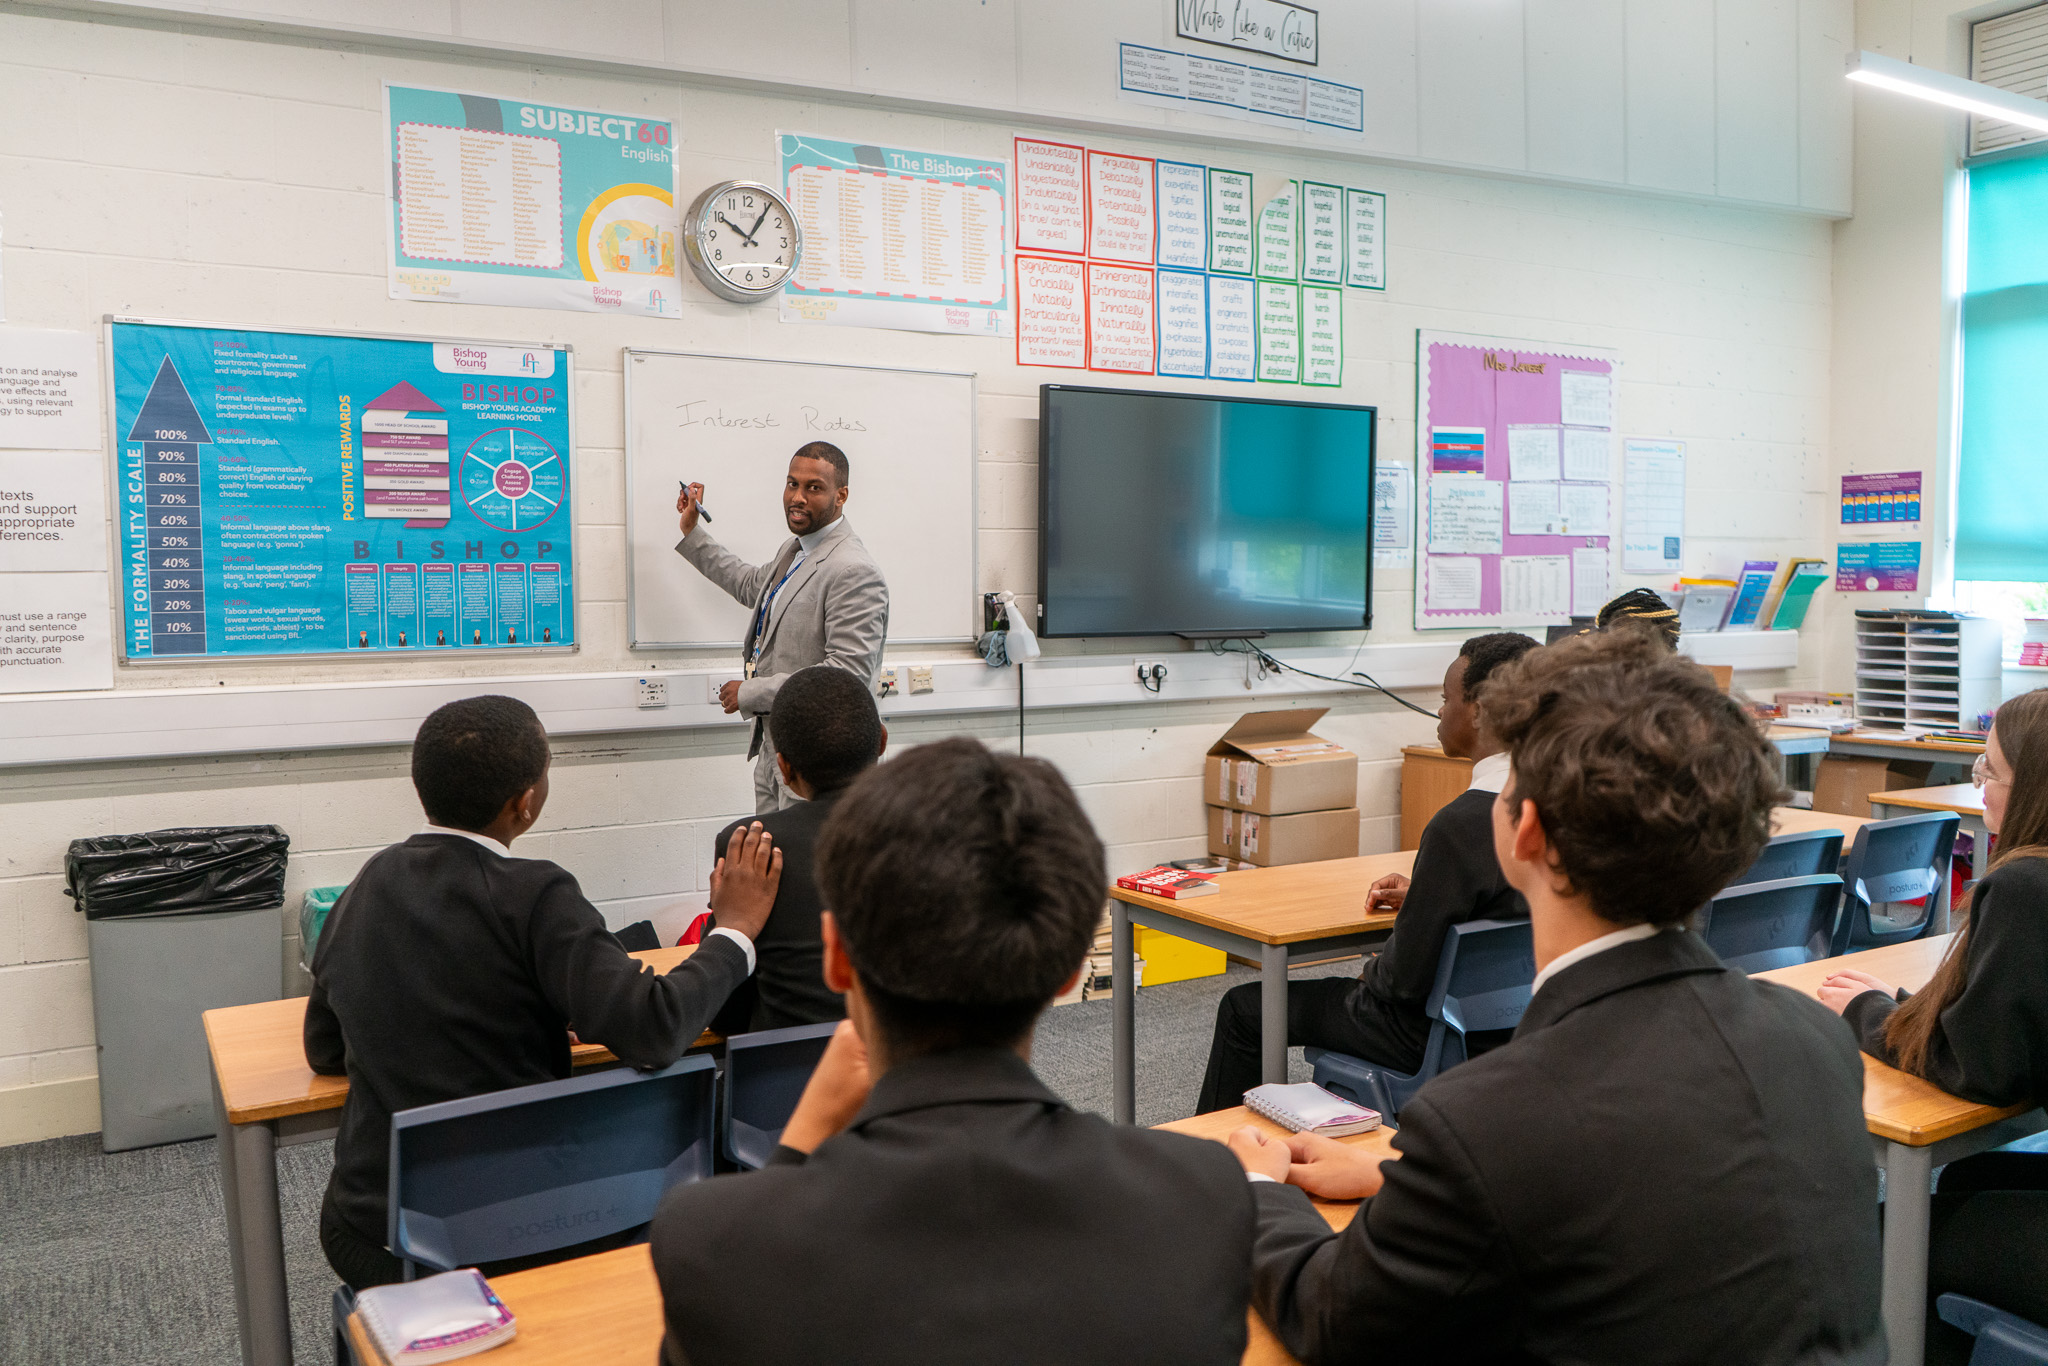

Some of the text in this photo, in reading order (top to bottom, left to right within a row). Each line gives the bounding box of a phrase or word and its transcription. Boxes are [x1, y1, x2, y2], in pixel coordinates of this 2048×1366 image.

[1182, 0, 1313, 52] Write Like a Critic
[622, 146, 668, 163] English
[1021, 143, 1078, 162] Undoubtedly
[890, 154, 920, 170] The
[924, 158, 973, 180] Bishop
[1025, 159, 1075, 176] Undeniably
[1103, 158, 1139, 173] Arguably
[1099, 171, 1143, 187] Debatably
[1104, 185, 1141, 201] Probably
[729, 199, 735, 210] 11
[743, 196, 753, 208] 12
[1099, 199, 1147, 216] Potentially
[714, 211, 724, 223] 10
[1107, 214, 1139, 229] Possibly
[775, 218, 782, 229] 2
[709, 230, 717, 241] 9
[780, 237, 787, 248] 3
[715, 249, 722, 260] 8
[775, 256, 782, 265] 4
[763, 267, 770, 278] 5
[1020, 260, 1080, 278] Significantly
[745, 270, 753, 281] 6
[1095, 269, 1147, 287] Inherently
[1029, 277, 1074, 293] Crucially
[593, 287, 622, 297] Bishop
[1091, 285, 1151, 303] Intrinsically
[593, 295, 621, 306] Young
[1033, 293, 1072, 309] Notably
[945, 309, 970, 318] Bishop
[1100, 302, 1143, 318] Innately
[946, 317, 969, 327] Young
[1024, 309, 1080, 324] Particularly
[1098, 318, 1146, 334] Naturally
[236, 351, 268, 359] formality
[453, 348, 487, 359] Bishop
[214, 359, 260, 367] courtrooms,
[454, 357, 487, 370] Young
[42, 369, 77, 378] analyse
[231, 368, 261, 376] religious
[263, 370, 299, 378] language.
[15, 387, 46, 395] effects
[462, 384, 556, 404] BISHOP
[7, 397, 73, 407] using relevant
[27, 409, 62, 417] support
[492, 404, 518, 412] YOUNG
[216, 412, 270, 420] undergraduate
[477, 412, 513, 420] LEARNING
[677, 400, 866, 432] Interest Rates
[154, 430, 187, 440] 100%
[252, 438, 280, 446] English.
[158, 451, 185, 461] 90%
[338, 394, 355, 521] POSITIVE REWARDS
[159, 473, 186, 482] 80%
[219, 473, 248, 481] correct)
[219, 482, 244, 490] quality
[0, 491, 34, 500] texts
[160, 494, 186, 504] 70%
[0, 504, 77, 516] nd support
[160, 516, 187, 525] 60%
[162, 537, 188, 546] 50%
[127, 449, 150, 652] THE FORMALITY SCALE
[162, 558, 189, 568] 40%
[163, 580, 190, 589] 30%
[164, 601, 191, 610] 20%
[57, 612, 86, 621] range
[29, 622, 77, 631] sentence
[166, 623, 191, 632] 10%
[5, 634, 84, 644] clarity, purpose
[16, 646, 61, 654] accurate
[1, 657, 64, 666] punctuation.
